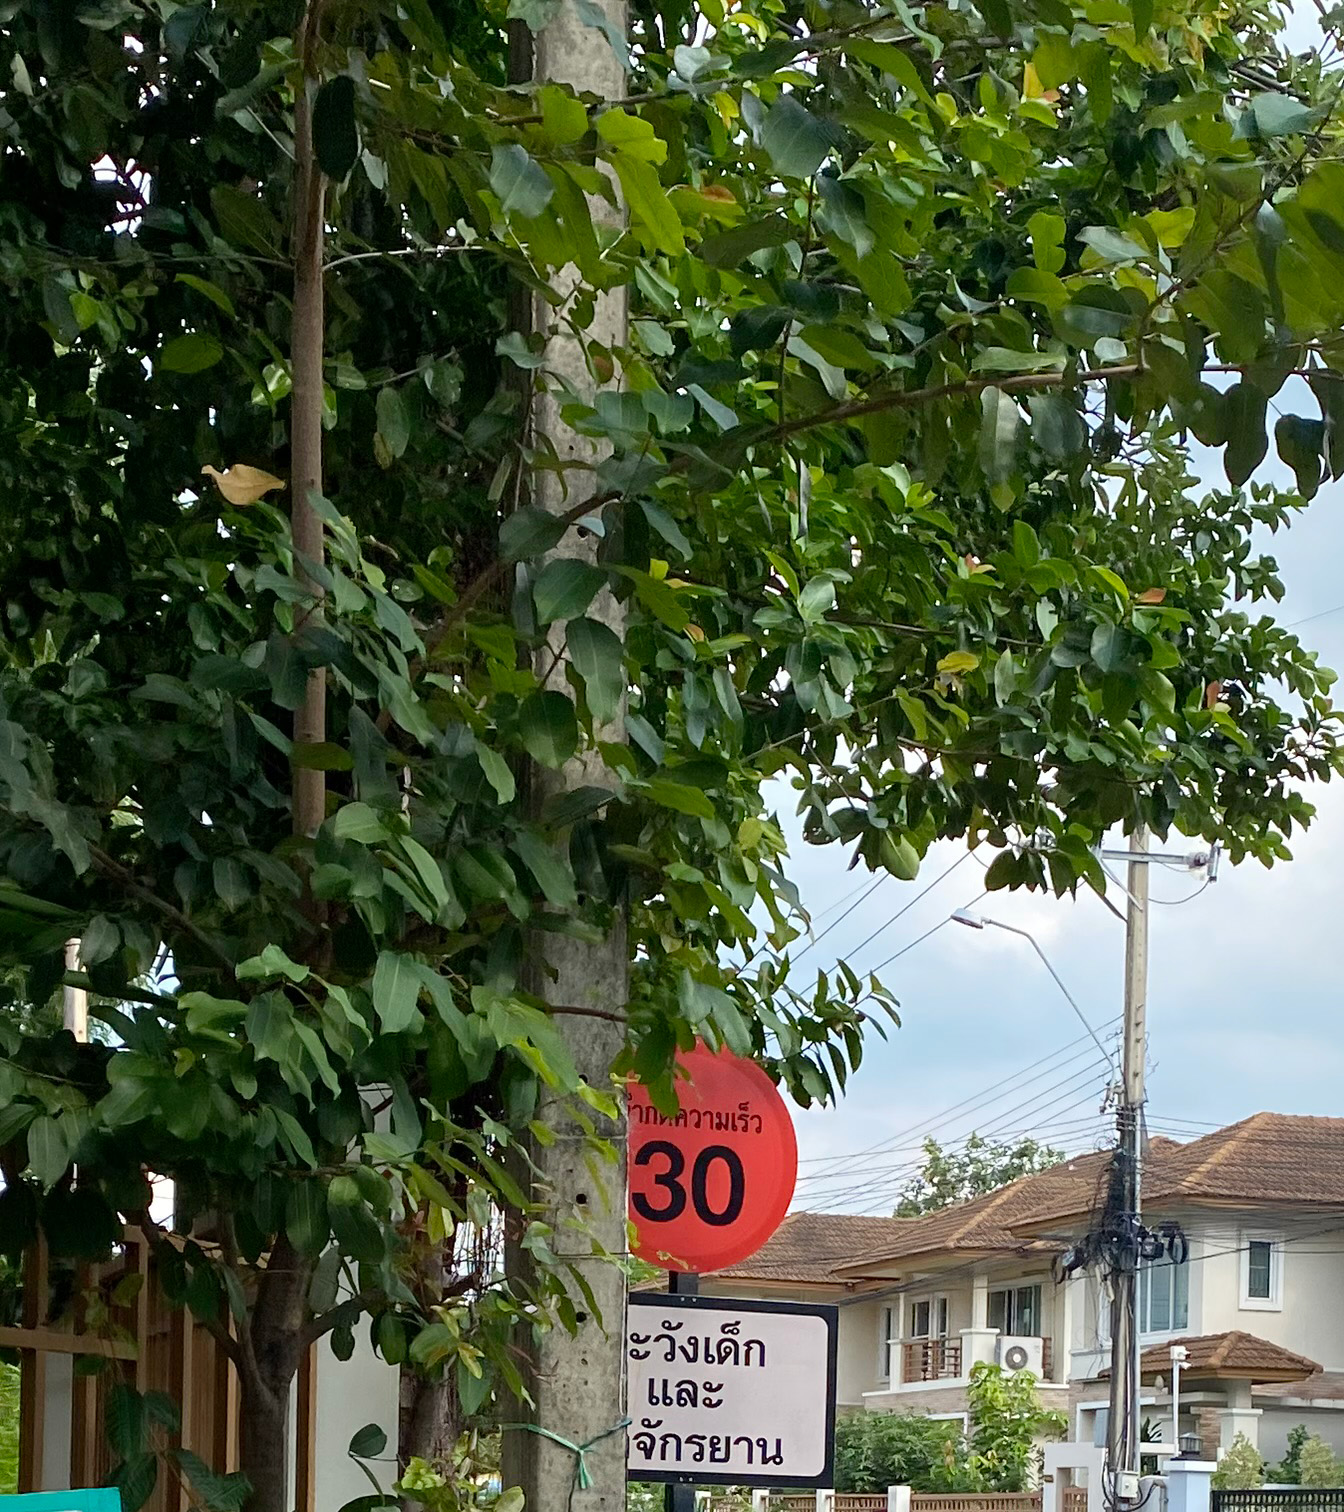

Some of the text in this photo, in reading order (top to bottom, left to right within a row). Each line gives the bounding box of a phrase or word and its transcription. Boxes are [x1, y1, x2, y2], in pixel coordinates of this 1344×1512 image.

[631, 1140, 746, 1227] 30
[629, 1319, 766, 1368] ะวังเด็ก
[647, 1377, 725, 1409] และ
[626, 1417, 784, 1466] จักรยาน
